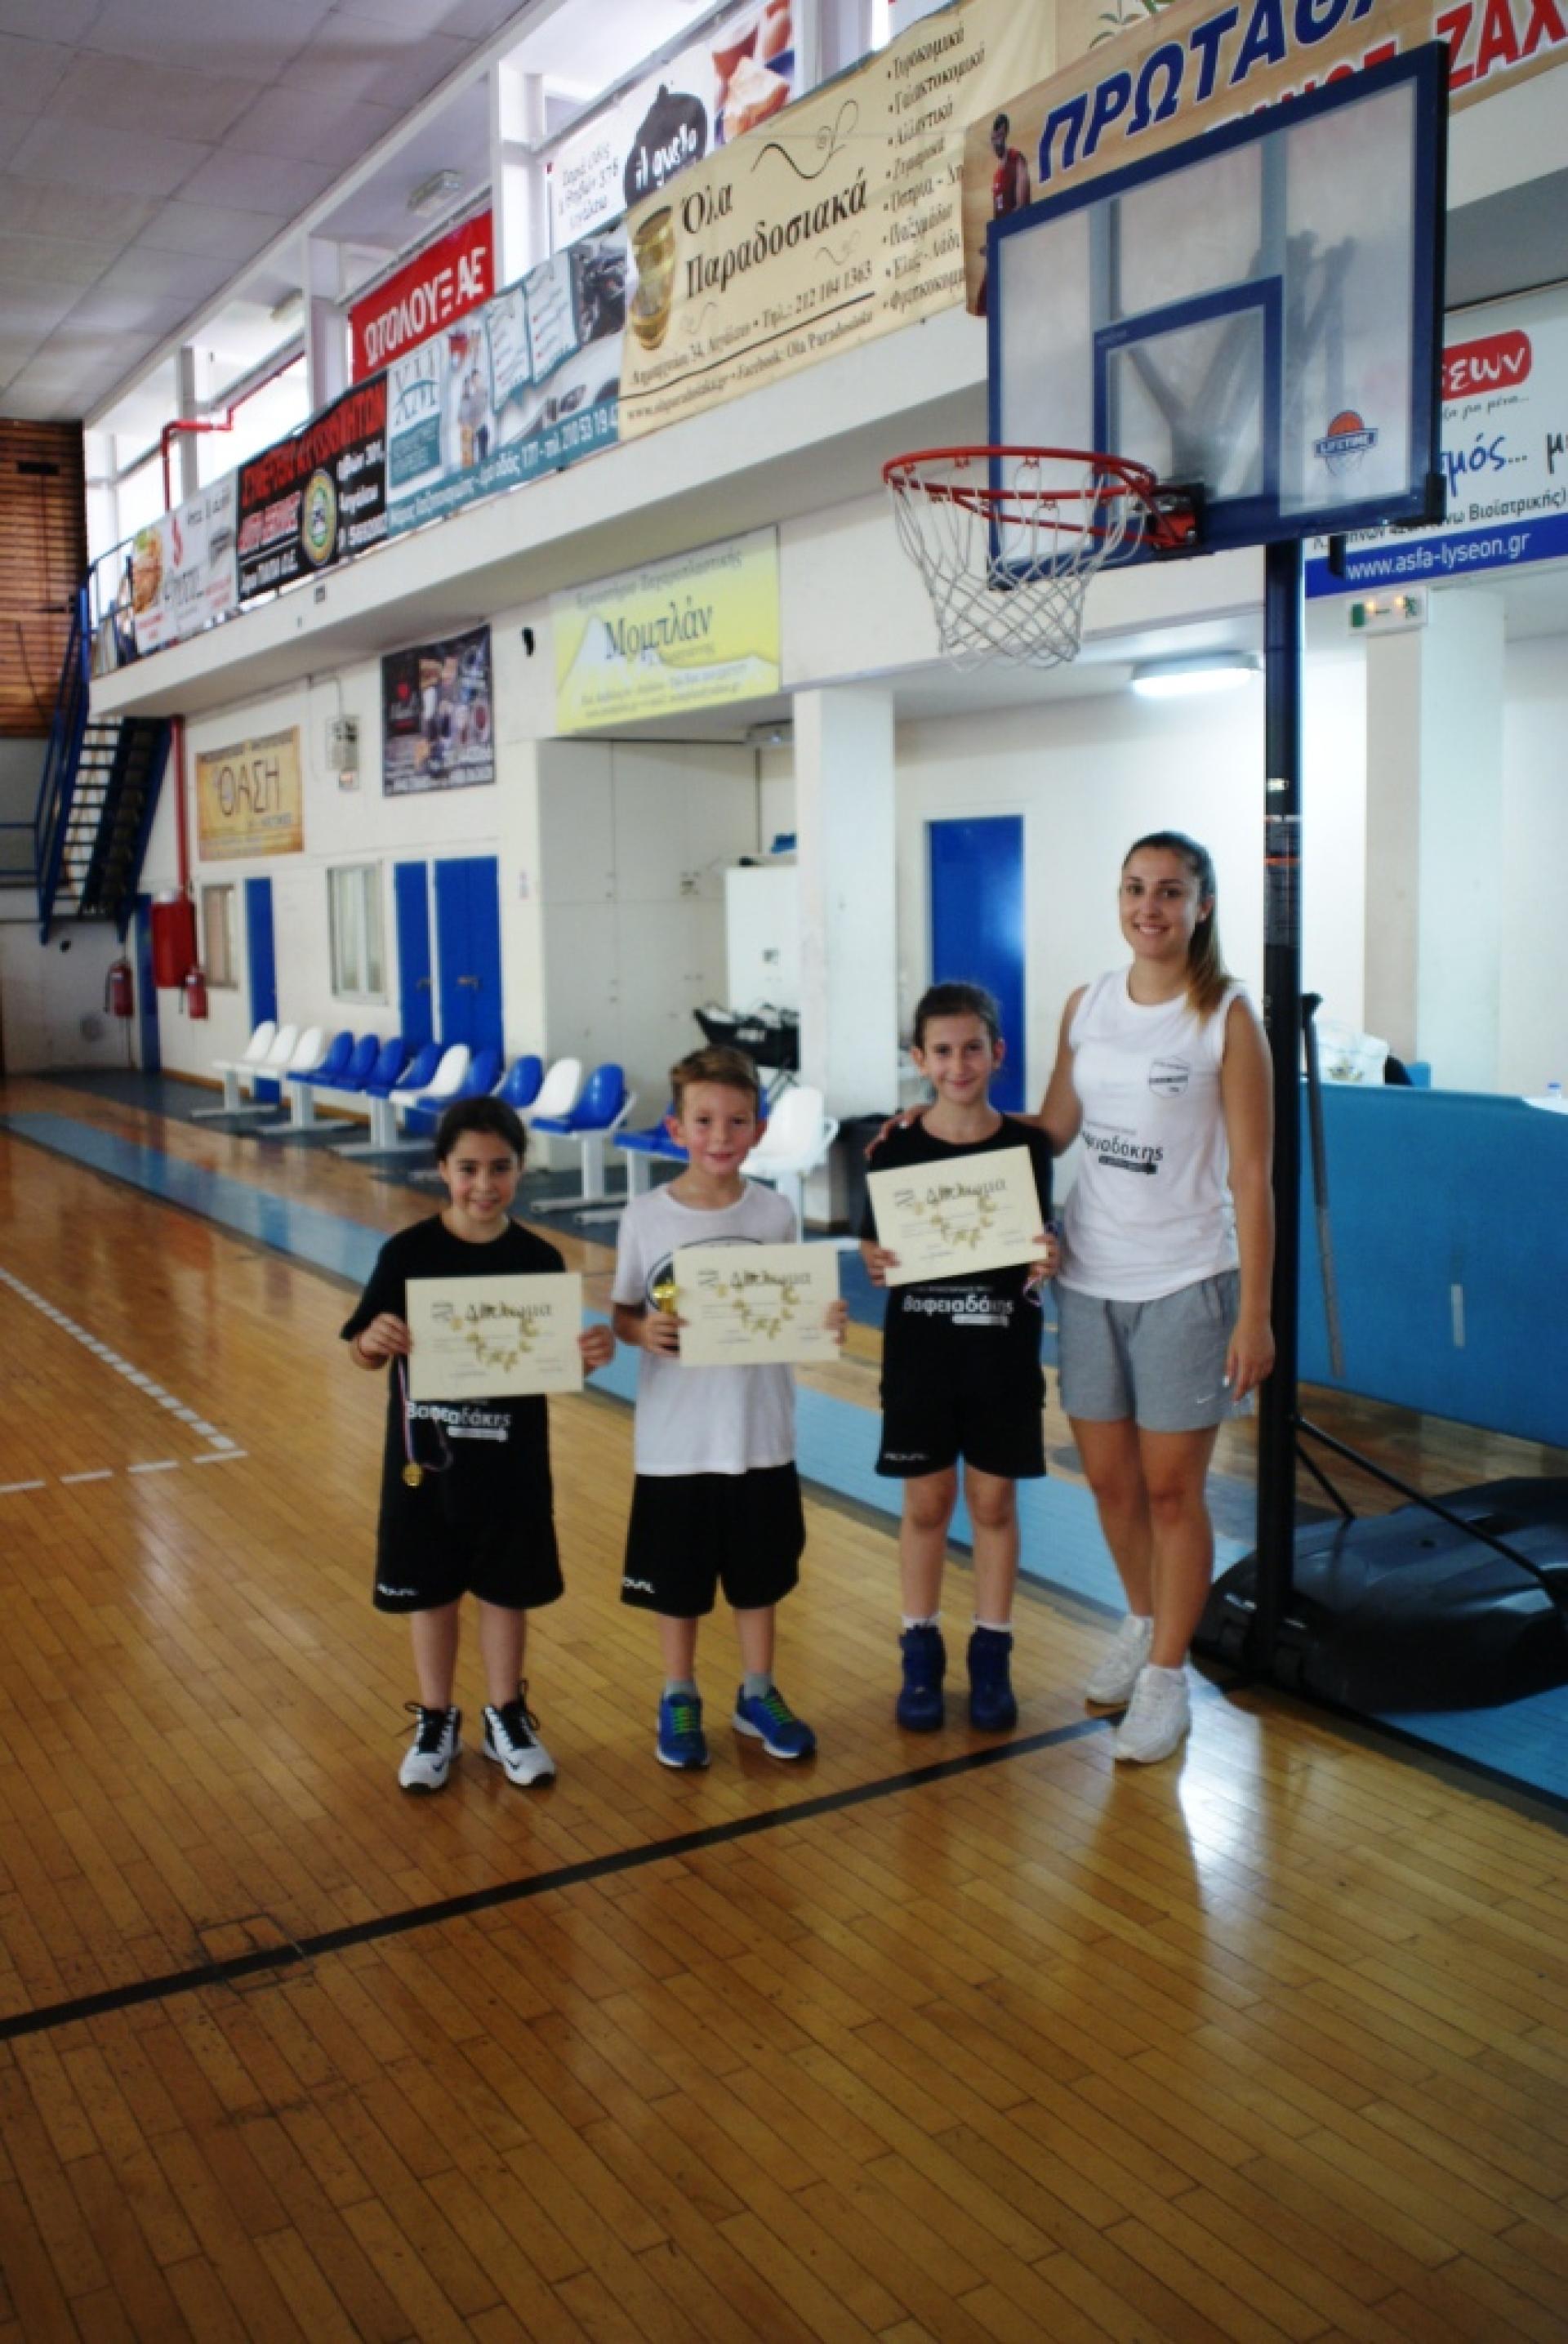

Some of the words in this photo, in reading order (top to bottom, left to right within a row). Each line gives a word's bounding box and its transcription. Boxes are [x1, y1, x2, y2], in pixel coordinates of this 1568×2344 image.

[1039, 0, 1374, 184] ΠΡΩΤΑΘ
[681, 180, 733, 236] Όλα
[686, 167, 868, 300] Παραδοσιακά
[1441, 346, 1526, 393] εων
[1347, 533, 1532, 581] www.asfa-lyseon.gr
[603, 595, 713, 660] Μομπλάν
